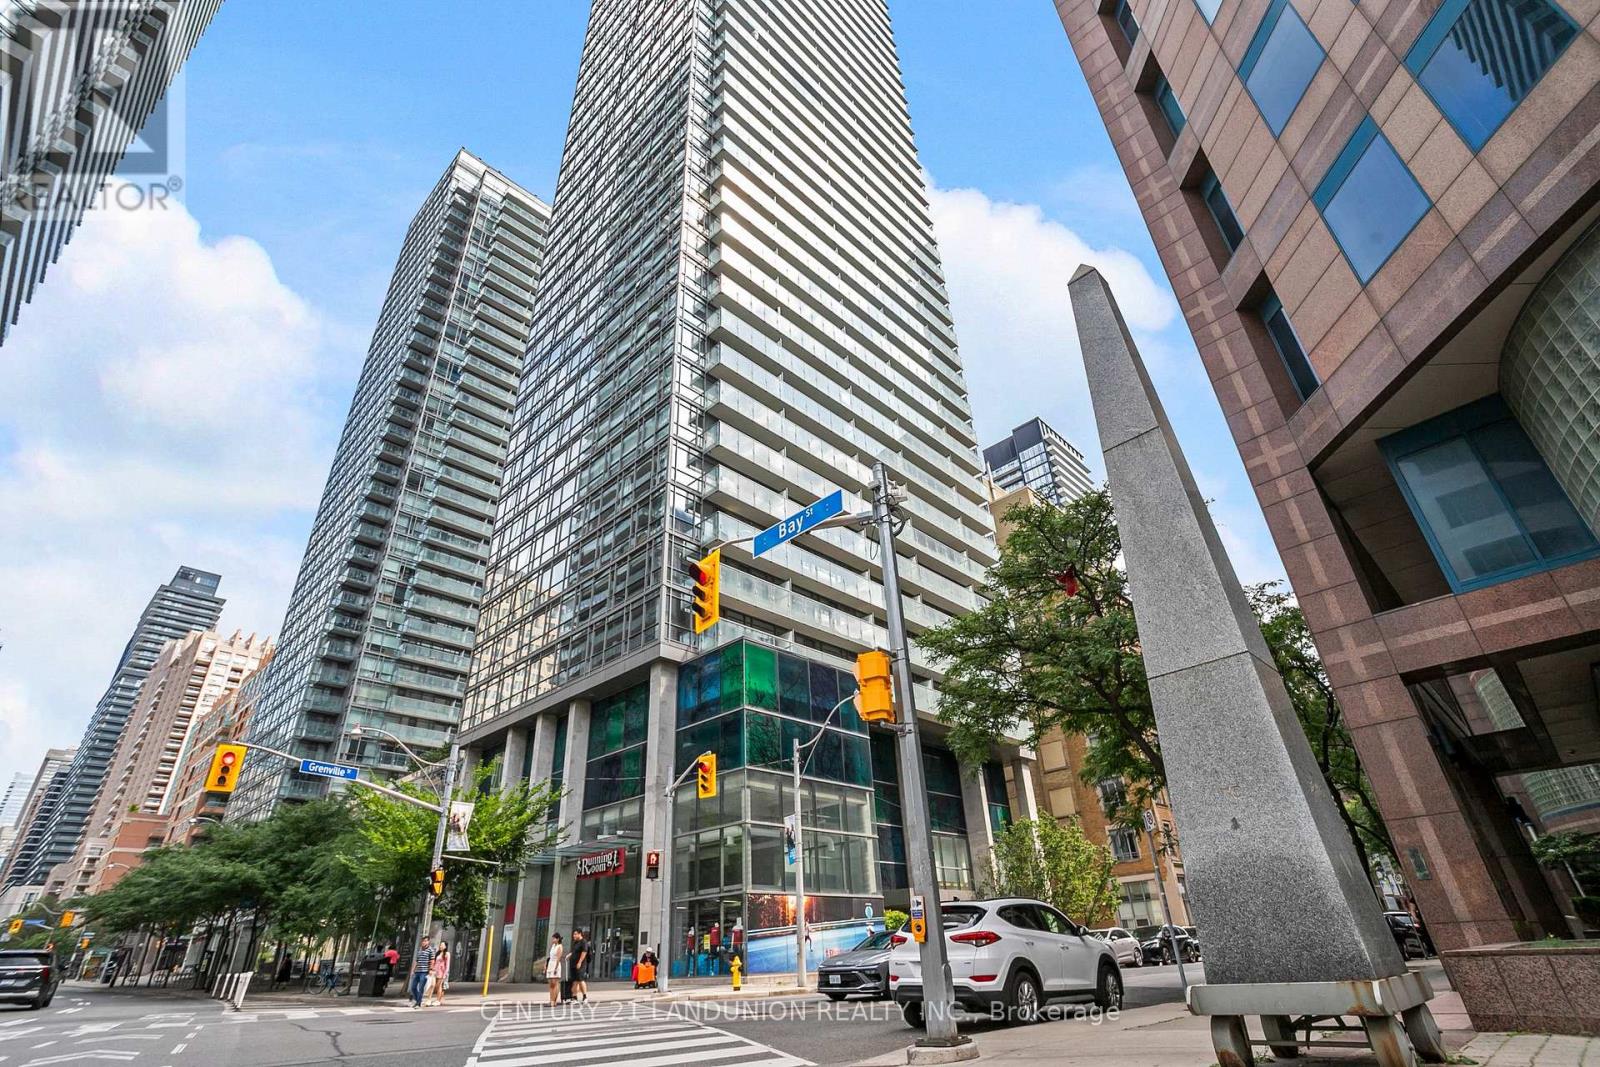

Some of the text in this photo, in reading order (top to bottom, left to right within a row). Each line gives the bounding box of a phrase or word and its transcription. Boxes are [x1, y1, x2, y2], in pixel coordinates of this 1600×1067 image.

[779, 515, 803, 538] Bay
[308, 762, 345, 776] Grenville
[581, 851, 613, 875] Running
